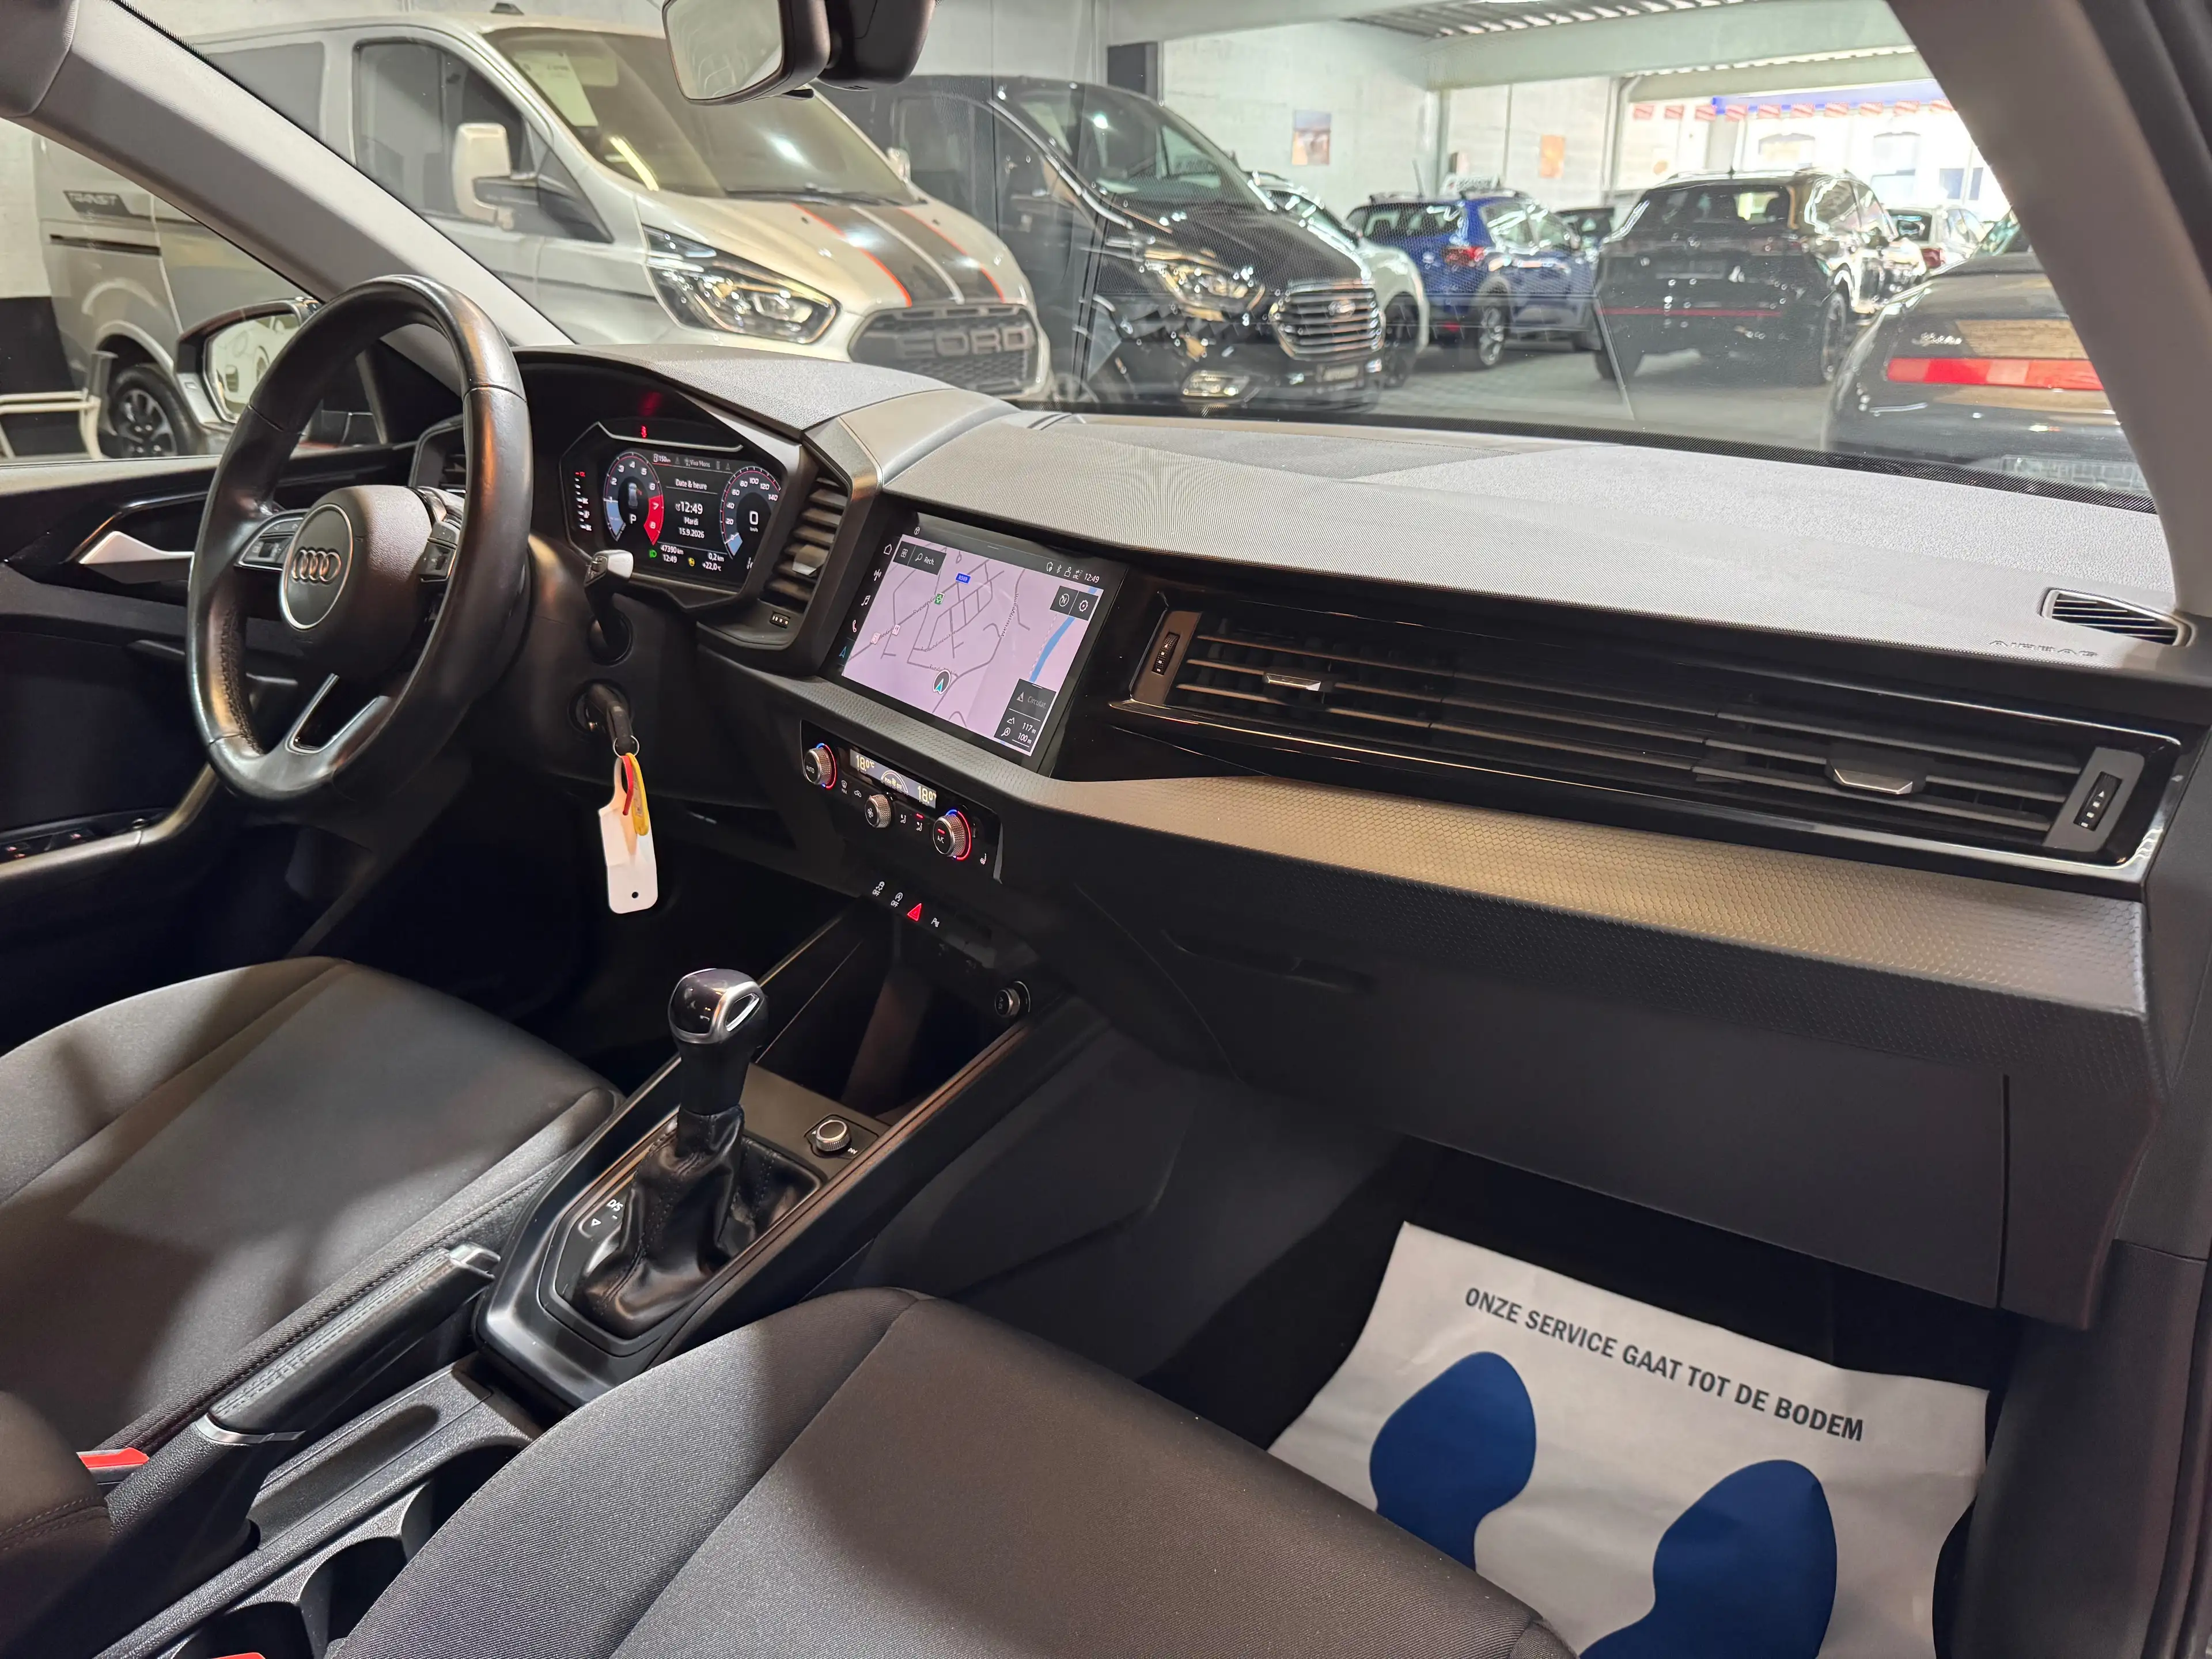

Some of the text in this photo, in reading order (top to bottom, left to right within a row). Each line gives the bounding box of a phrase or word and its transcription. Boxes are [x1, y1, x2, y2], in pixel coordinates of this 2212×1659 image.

[896, 324, 1034, 359] FORD
[676, 479, 687, 487] Date
[693, 482, 707, 490] heure
[768, 493, 778, 501] 140
[680, 501, 703, 514] 12:49
[630, 514, 637, 524] P
[684, 517, 699, 526] Mardi
[749, 511, 758, 525] 0
[679, 527, 704, 539] 15.9.2026
[661, 544, 676, 554] 47390
[662, 554, 677, 563] 12:49
[707, 552, 717, 561] 0,2
[923, 556, 934, 566] Rech.
[1084, 573, 1100, 583] 12:49
[1989, 640, 2099, 657] AIRBAG
[1027, 696, 1047, 709] Circulat.
[1022, 722, 1033, 732] 117
[1018, 732, 1028, 743] 100
[806, 765, 815, 774] AUTO
[606, 1199, 623, 1211] D/S
[1465, 1287, 1864, 1442] ONZE SERVICE GAAT TOT DE BODEM
